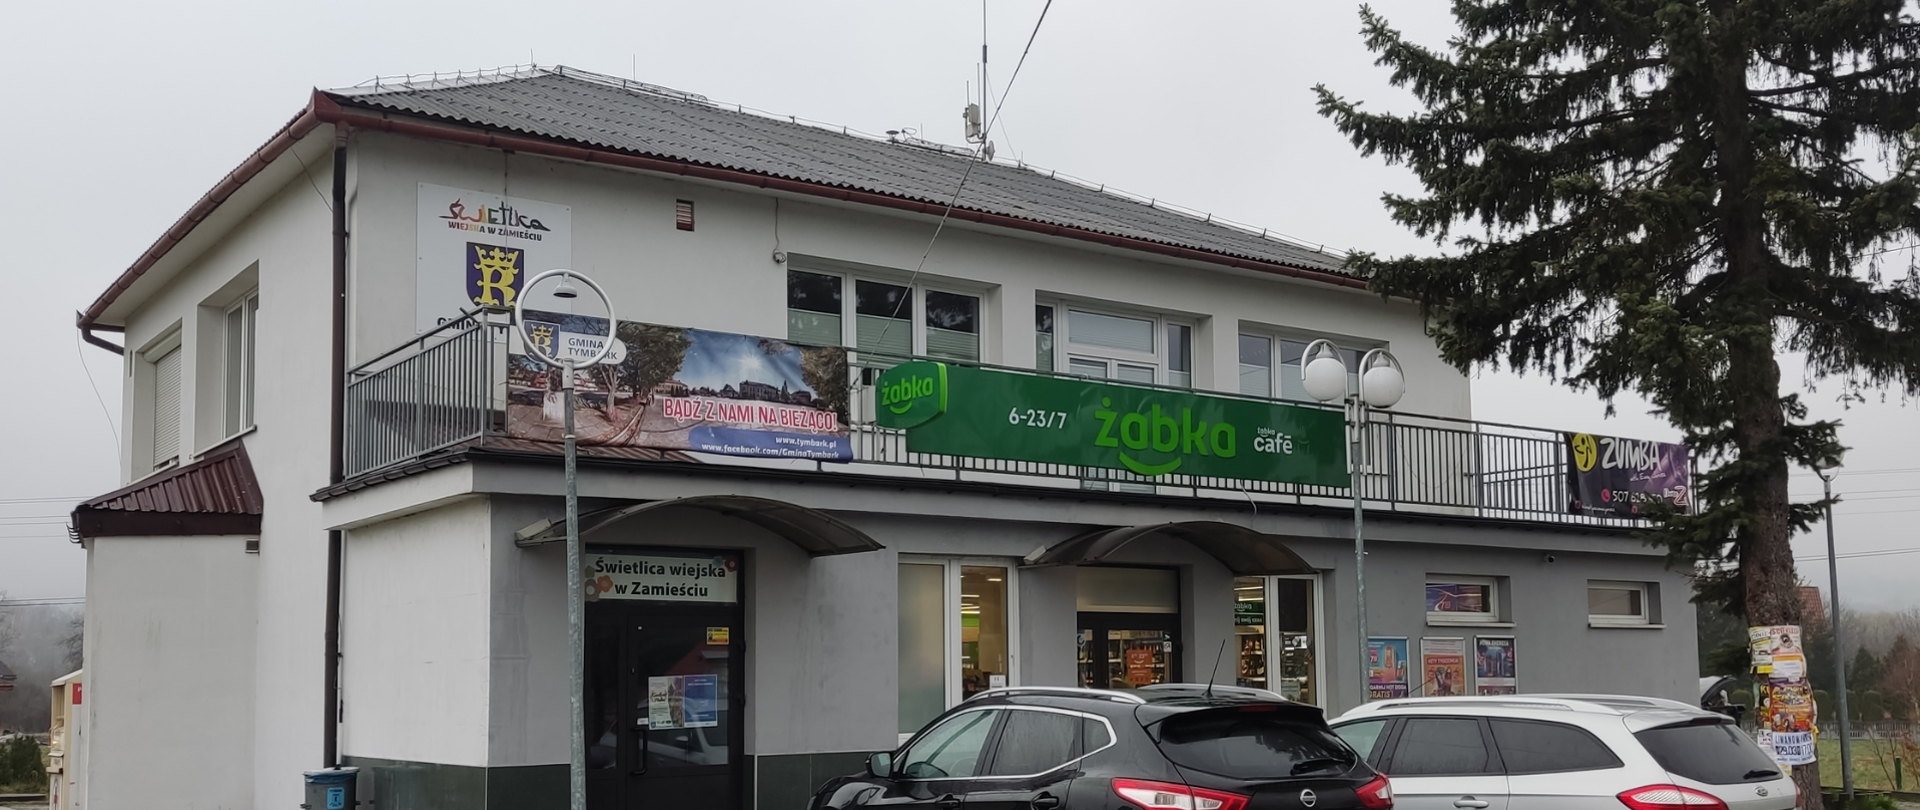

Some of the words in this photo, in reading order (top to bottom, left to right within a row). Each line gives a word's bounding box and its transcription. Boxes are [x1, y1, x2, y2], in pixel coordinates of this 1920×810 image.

[448, 220, 485, 234] WIEJSKA
[487, 226, 496, 235] W
[498, 228, 542, 242] ZAMIEŚCIU
[568, 337, 604, 349] GMINA
[568, 347, 618, 360] TYMBARK
[881, 375, 933, 406] żabka
[663, 396, 703, 422] BĄDŹ
[706, 401, 714, 418] Z
[718, 402, 755, 421] NAMI
[758, 406, 776, 424] NA
[780, 405, 838, 433] BIEŻĄCO!
[1008, 406, 1067, 430] 6-23/7
[1094, 397, 1236, 459] żabka
[702, 443, 839, 459] www.facebook.com/GminaTymbark
[775, 435, 837, 449] www.tymbark.pl
[1600, 437, 1662, 472] ZUMBA
[1612, 490, 1630, 503] 507
[595, 557, 665, 576] Świetlica
[669, 563, 726, 580] wiejska
[615, 584, 628, 594] w
[631, 582, 708, 597] Zamieściu
